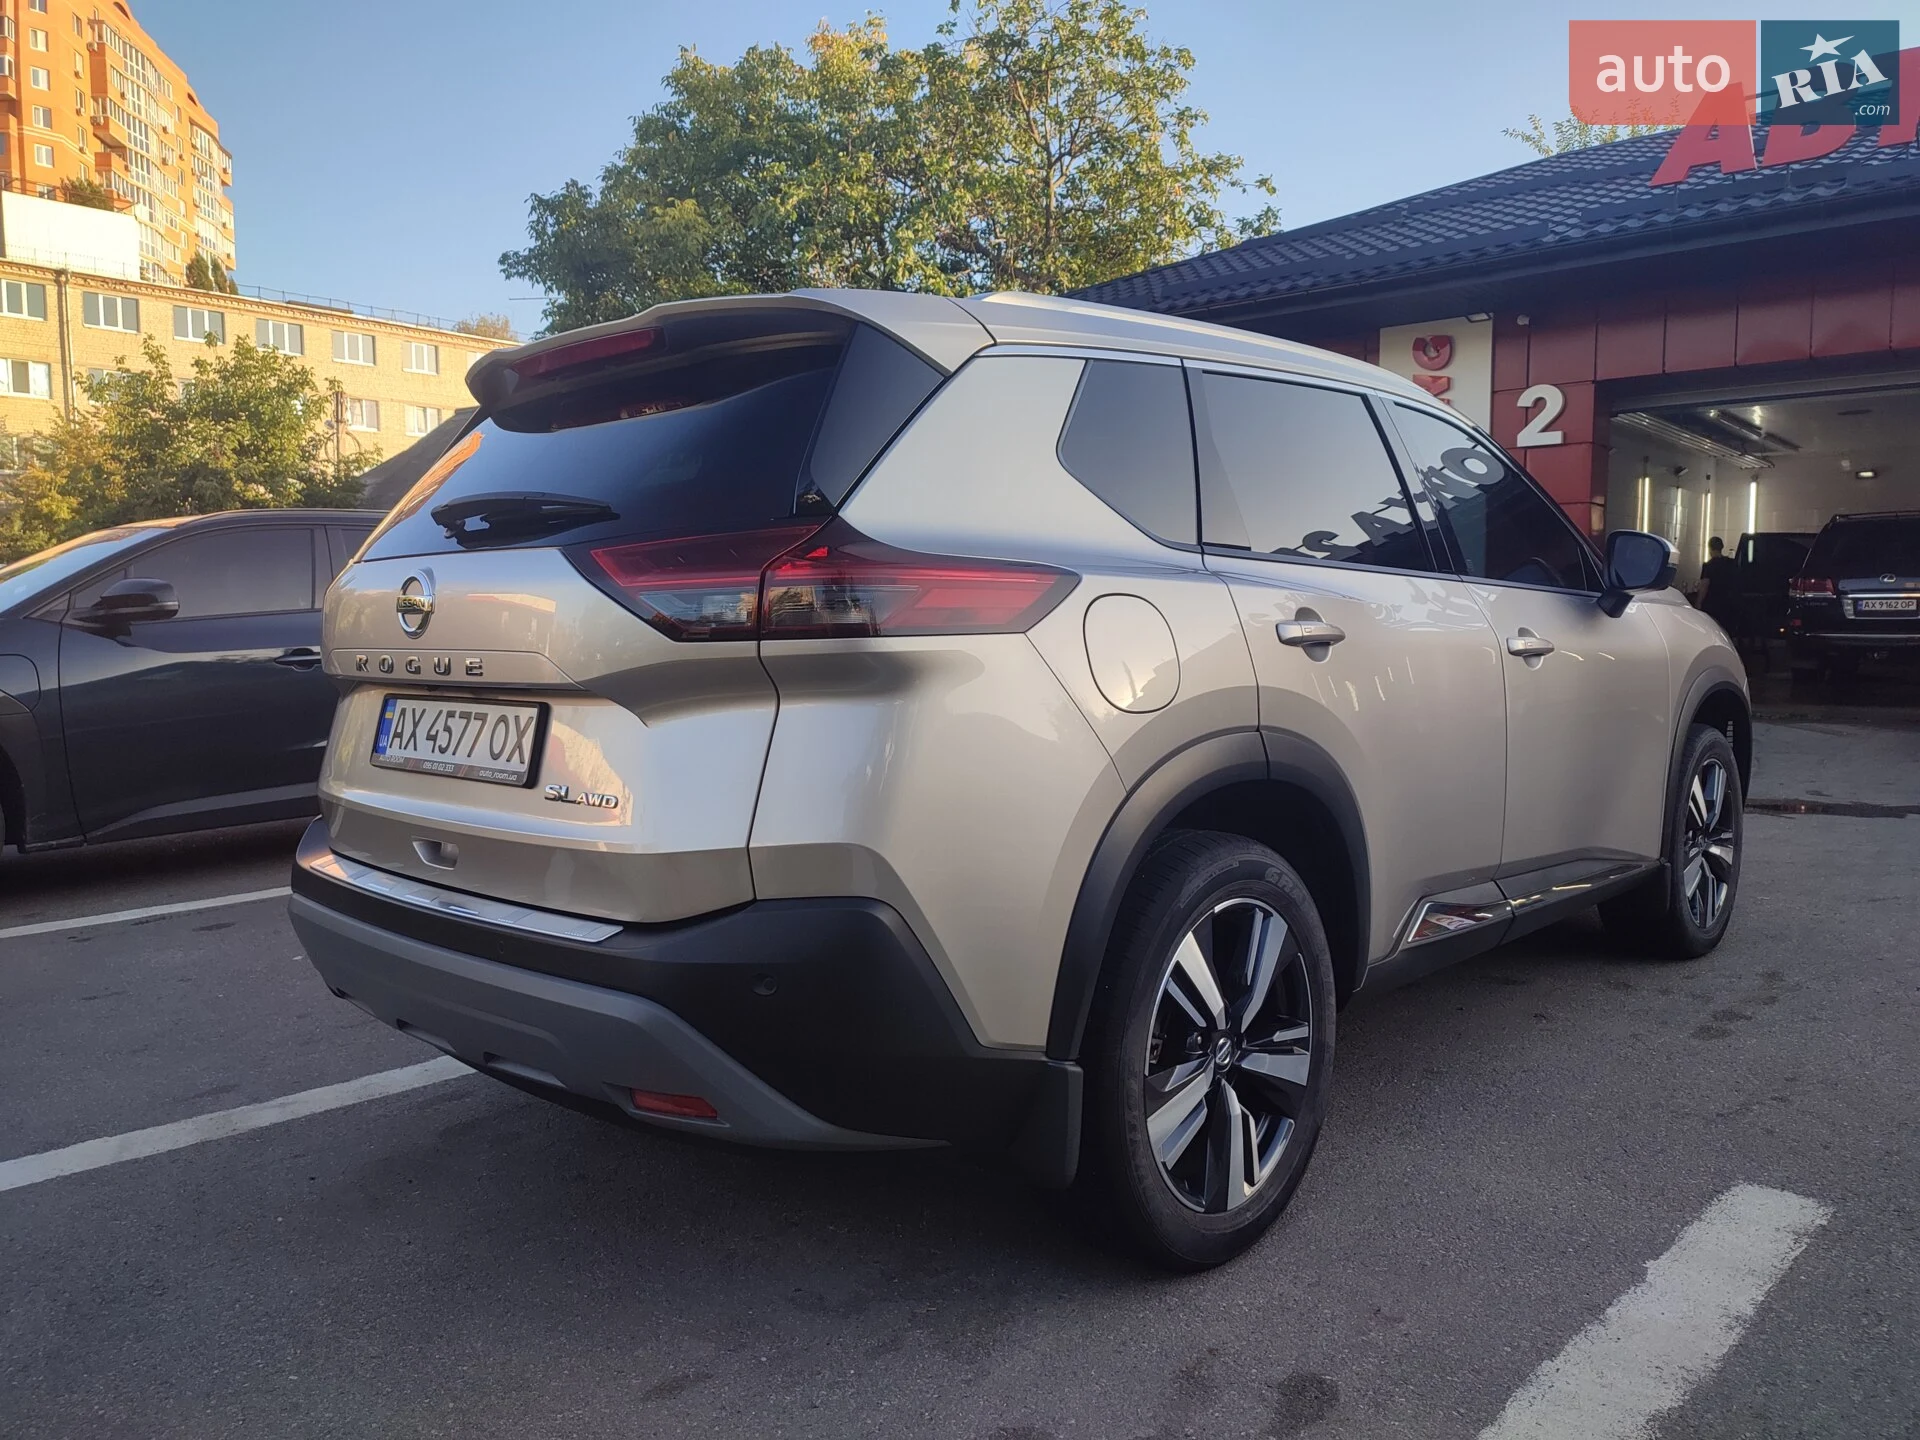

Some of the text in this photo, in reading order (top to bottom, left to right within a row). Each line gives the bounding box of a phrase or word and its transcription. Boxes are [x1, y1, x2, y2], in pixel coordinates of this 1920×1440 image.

[1516, 384, 1565, 447] 2
[1863, 601, 1915, 609] AX 9162 OP
[355, 654, 483, 677] ROGUE
[390, 707, 535, 765] AX 4577 OX
[545, 783, 619, 810] SL AWD
